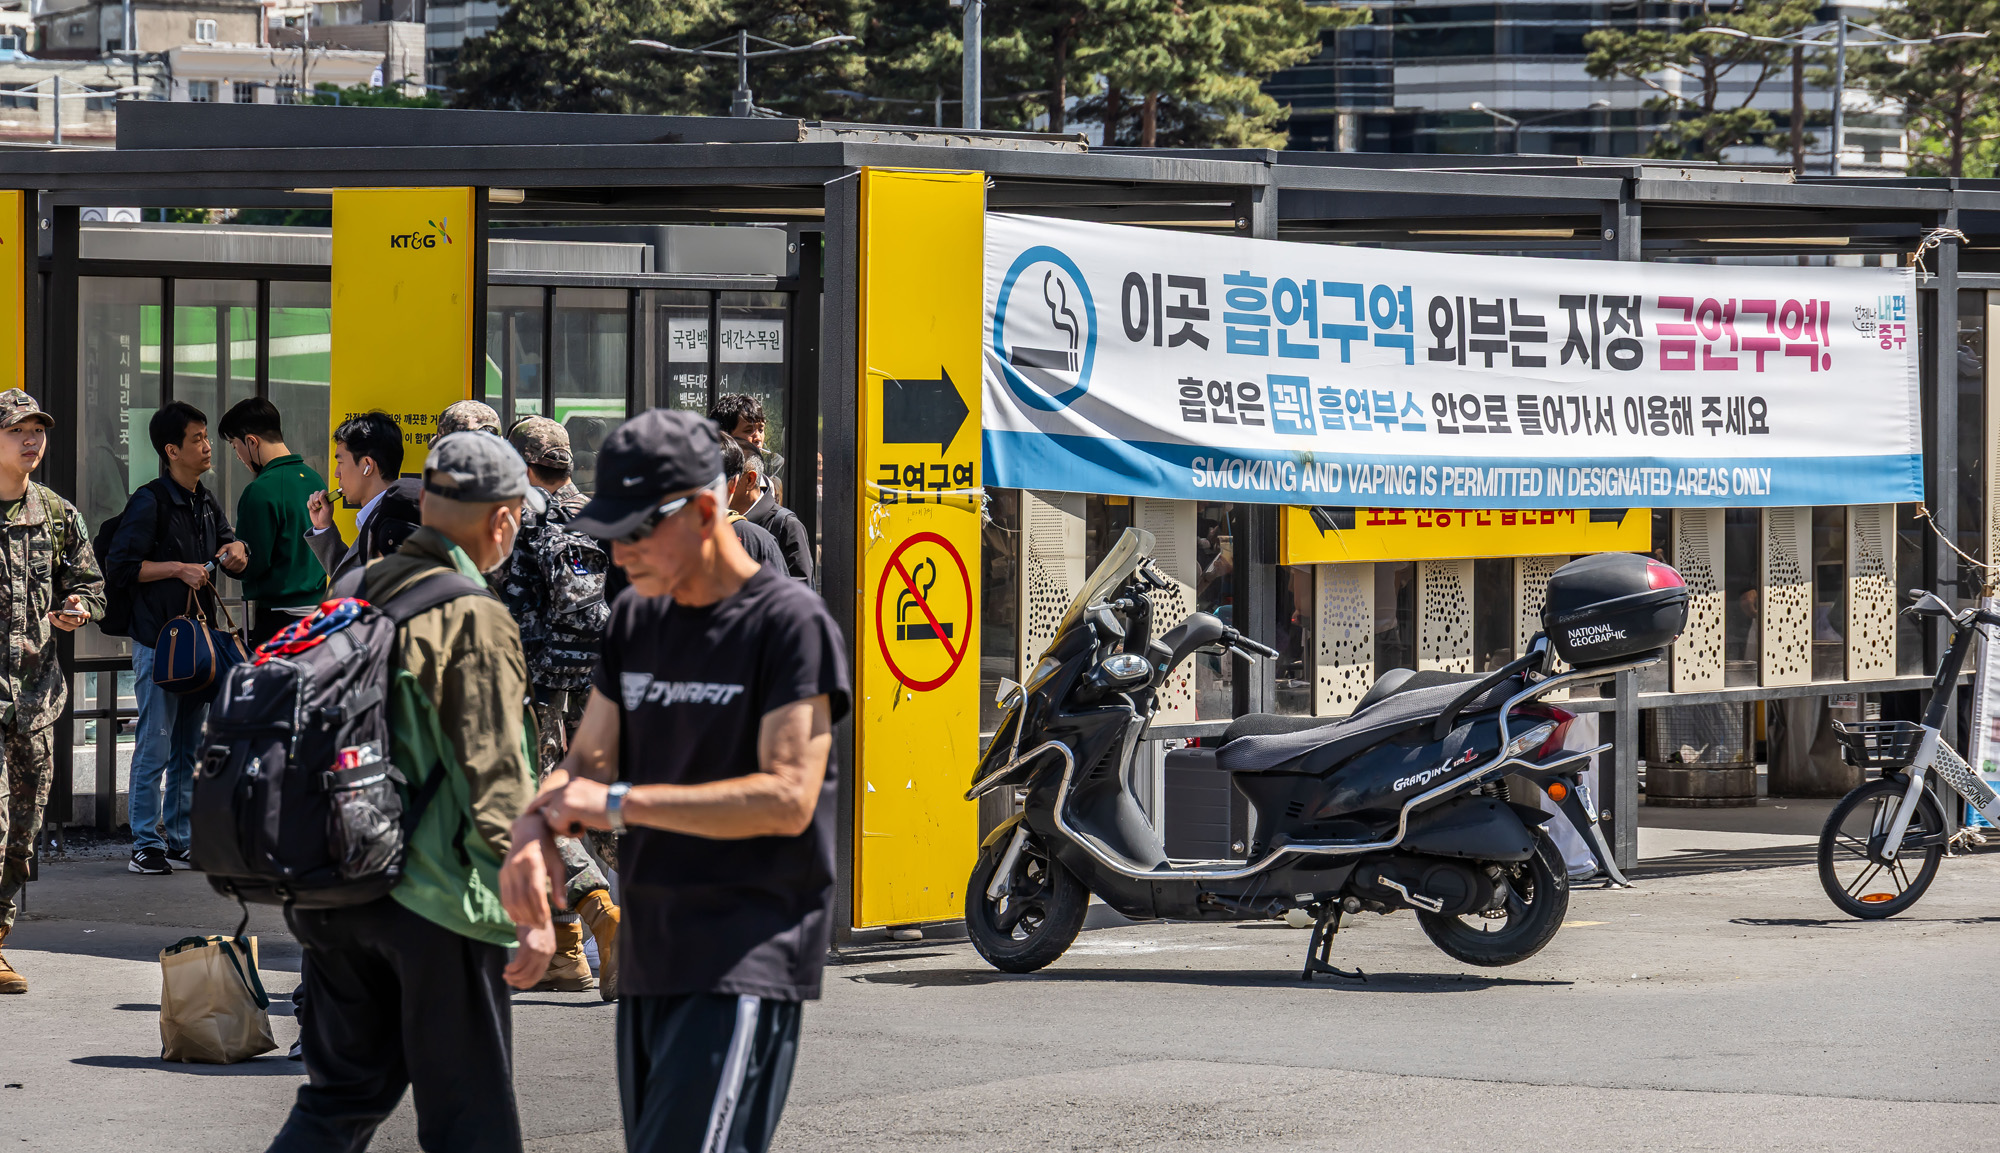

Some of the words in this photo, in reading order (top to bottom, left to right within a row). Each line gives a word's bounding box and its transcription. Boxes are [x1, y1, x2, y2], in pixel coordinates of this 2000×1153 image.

[391, 231, 435, 249] KT&G
[1121, 271, 1210, 352] 이곳
[1223, 270, 1415, 366] 흡연구역
[1427, 295, 1548, 369] 외부는
[1558, 293, 1644, 371] 지정
[1656, 296, 1832, 373] 금연구역!
[673, 329, 781, 350] 국립백대간수목원
[1177, 376, 1266, 427] 흡연은
[1272, 383, 1313, 430] 꼭!
[1317, 385, 1427, 433] 흡연부스
[1431, 392, 1512, 435] 안으로
[1517, 394, 1617, 437] 들어가서
[1624, 395, 1695, 437] 이용해
[1701, 396, 1770, 436] 주세요
[403, 413, 428, 425] 깨끗한
[877, 462, 974, 504] 금연구역
[1191, 456, 1297, 492] SMOKING
[1301, 461, 1342, 493] AND
[1346, 463, 1416, 496] VAPING
[1420, 465, 1438, 496] IS
[1441, 466, 1543, 497] PERMITTED
[1547, 467, 1564, 497] IN
[1567, 467, 1672, 497] DESIGNATED
[1675, 467, 1729, 496] AREAS
[1732, 467, 1772, 496] ONLY
[1568, 623, 1613, 639] NATIONAL
[1570, 630, 1628, 647] GEOGRAPHIC
[645, 681, 744, 706] DYNAFIT
